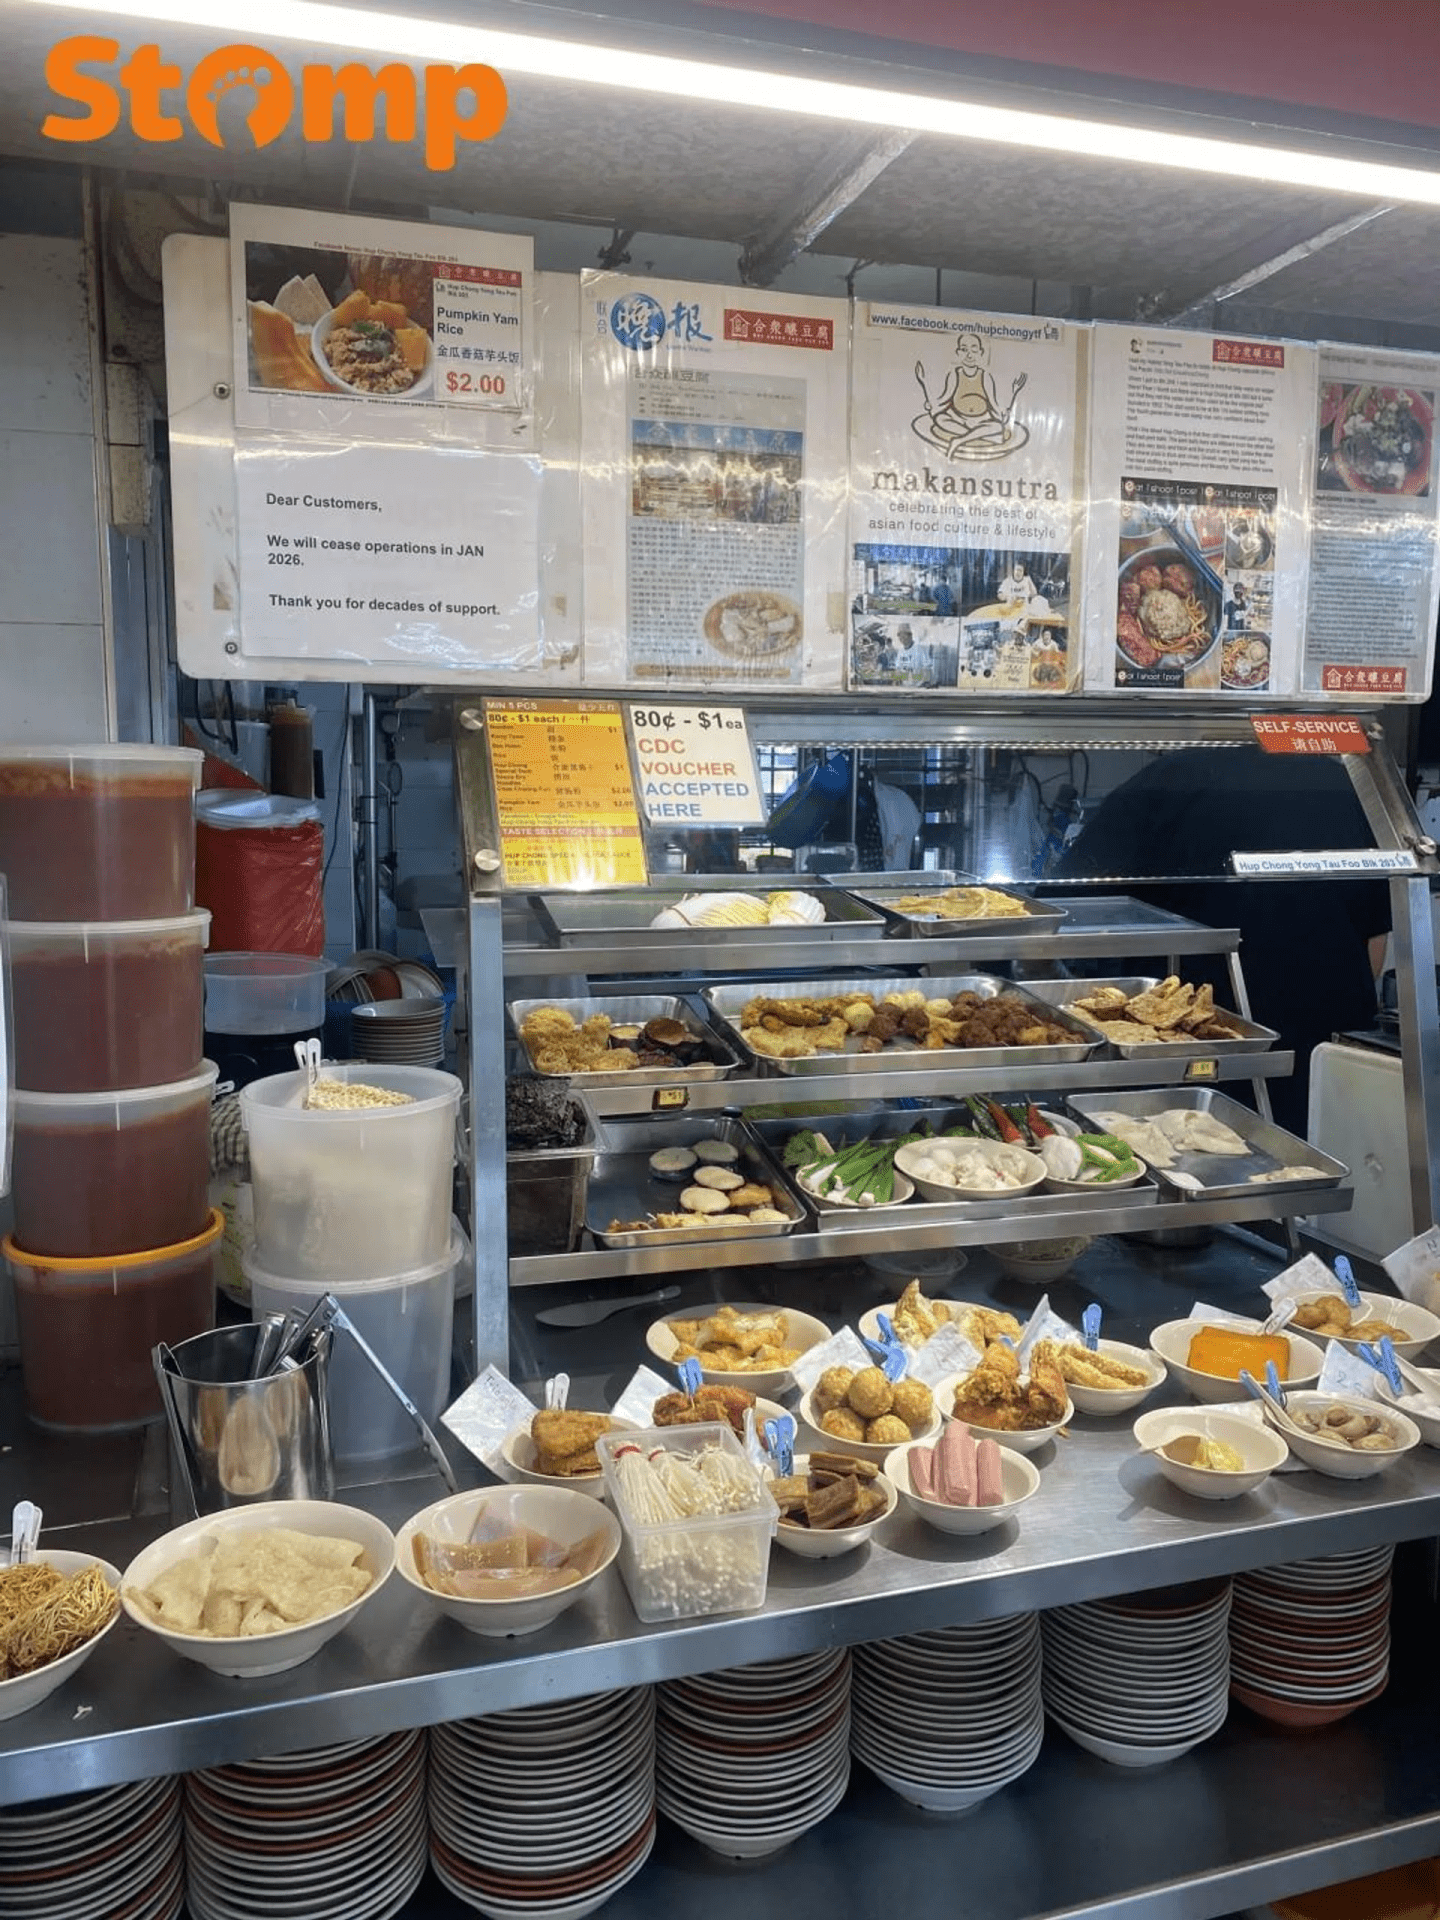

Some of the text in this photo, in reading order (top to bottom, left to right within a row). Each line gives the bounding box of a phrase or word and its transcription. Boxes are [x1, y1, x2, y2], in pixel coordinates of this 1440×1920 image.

[437, 306, 519, 326] Pumpkin Yam
[437, 321, 464, 335] Rice
[871, 313, 1042, 340] www.facebook.com/hupchongytf
[437, 344, 520, 364] 金瓜香菇芋头饭
[446, 372, 506, 396] $2.00
[872, 468, 1058, 500] makansutra
[266, 493, 382, 512] Dear Customers,
[889, 501, 1038, 521] celebrating the best of
[869, 518, 1056, 540] asian food culture & lifestyle
[267, 535, 484, 557] We will cease operations in JAN
[268, 553, 304, 566] 2026.
[269, 594, 501, 617] Thank you for decades of support.
[487, 702, 507, 710] MIN
[517, 702, 538, 710] PCS
[518, 714, 530, 723] $1
[534, 715, 560, 724] each
[634, 711, 676, 730] 80¢
[1253, 721, 1360, 733] SELF-SERVICE
[638, 738, 686, 754] CDC
[641, 762, 736, 777] VOUCHER
[645, 783, 749, 797] ACCEPTED
[649, 803, 702, 817] HERE
[1240, 858, 1396, 871] Hup Chong Yong Tau Foo Blk 203
